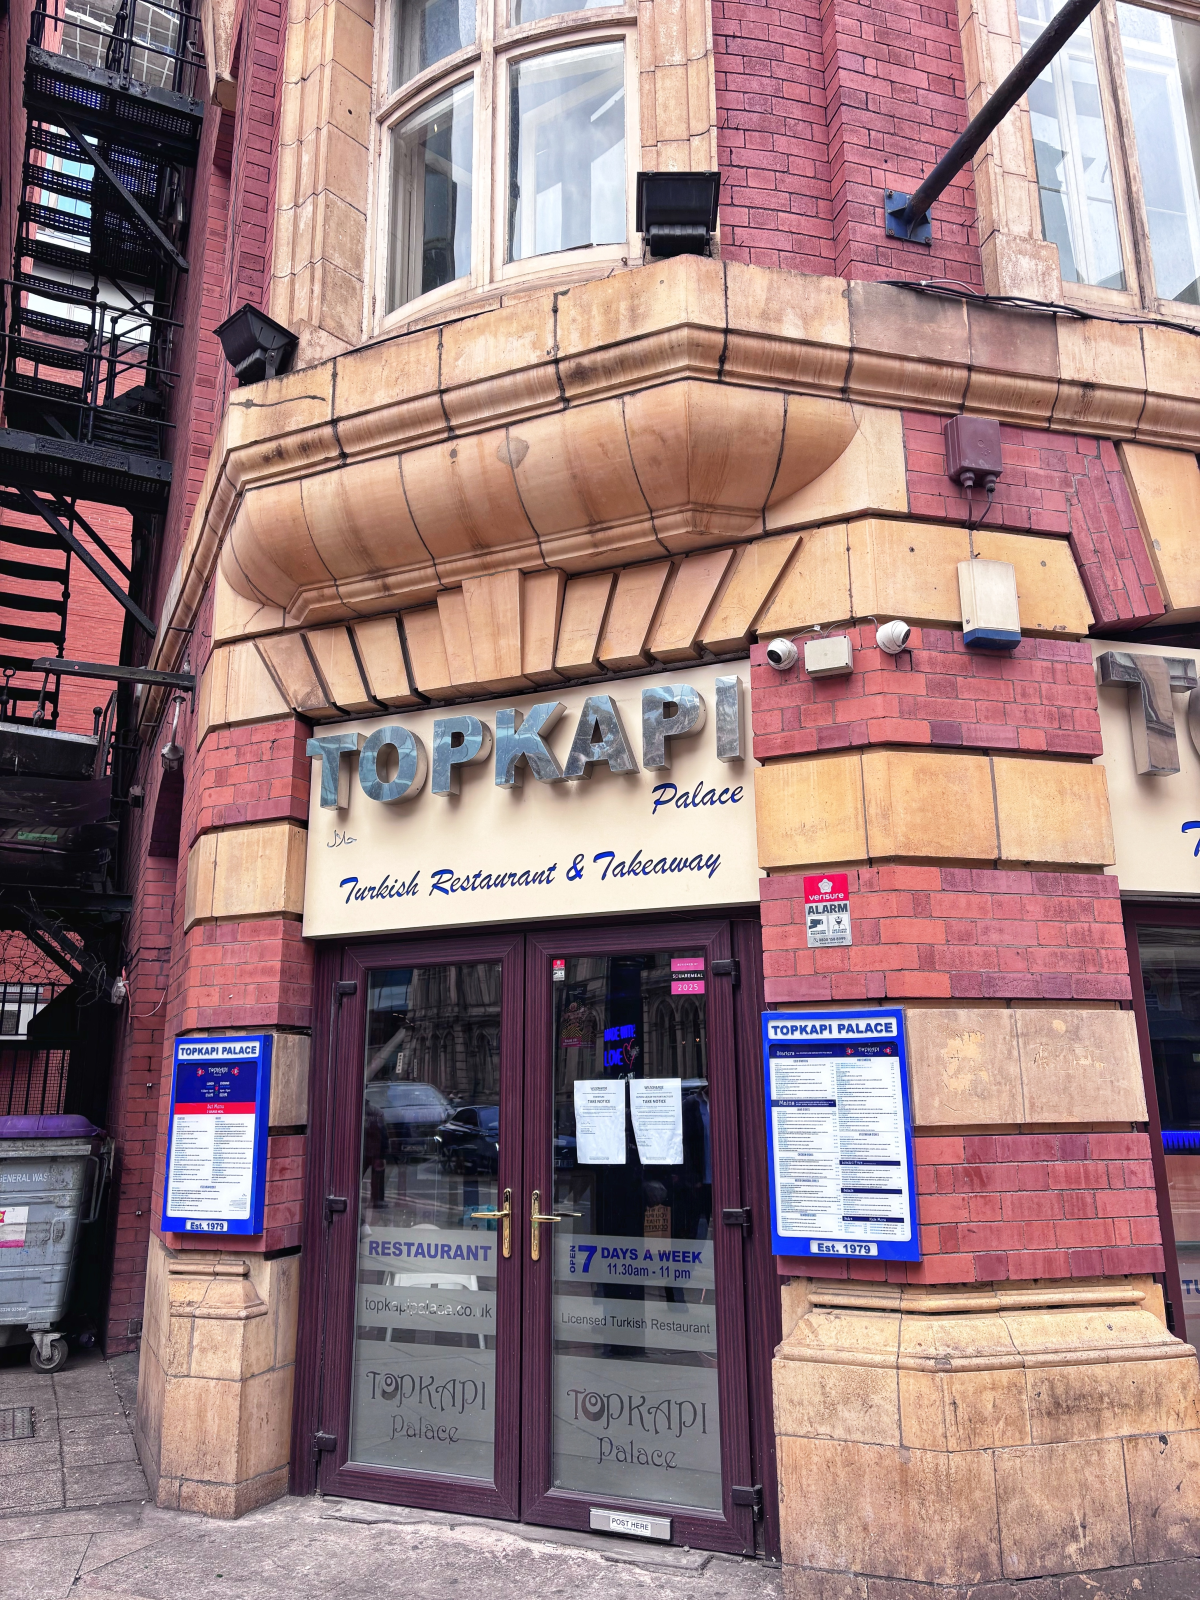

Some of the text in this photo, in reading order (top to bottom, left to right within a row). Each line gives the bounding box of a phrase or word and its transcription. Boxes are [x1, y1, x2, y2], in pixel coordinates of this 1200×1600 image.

[306, 674, 746, 812] TOPKAPI
[651, 781, 744, 815] Palace
[327, 829, 357, 848] حلال
[339, 848, 722, 905] Turkish Restaurant & Takeaway
[808, 892, 844, 901] verisure
[807, 903, 849, 916] ALARM
[677, 983, 699, 991] 2025
[771, 1022, 894, 1036] TOPKAPI PALACE
[180, 1045, 257, 1056] TOPKAPI PALACE
[604, 1048, 623, 1067] LOVE
[190, 1222, 224, 1230] Est. 1979
[368, 1240, 492, 1262] RESTAURANT
[817, 1242, 871, 1255] Est. 1979
[578, 1245, 703, 1273] 7 DAYS A WEEK
[607, 1263, 649, 1277] 11.30am
[659, 1265, 670, 1278] 11
[674, 1269, 691, 1281] pm
[365, 1297, 492, 1319] topkapipalace.co.uk
[561, 1312, 710, 1334] Licensed Turkish Restaurant
[366, 1370, 486, 1414] TOPKAPI
[567, 1388, 707, 1438] TOPKAPI
[389, 1414, 460, 1444] Palace
[596, 1436, 678, 1471] Palace
[611, 1517, 629, 1527] POST
[630, 1521, 649, 1531] HERE
